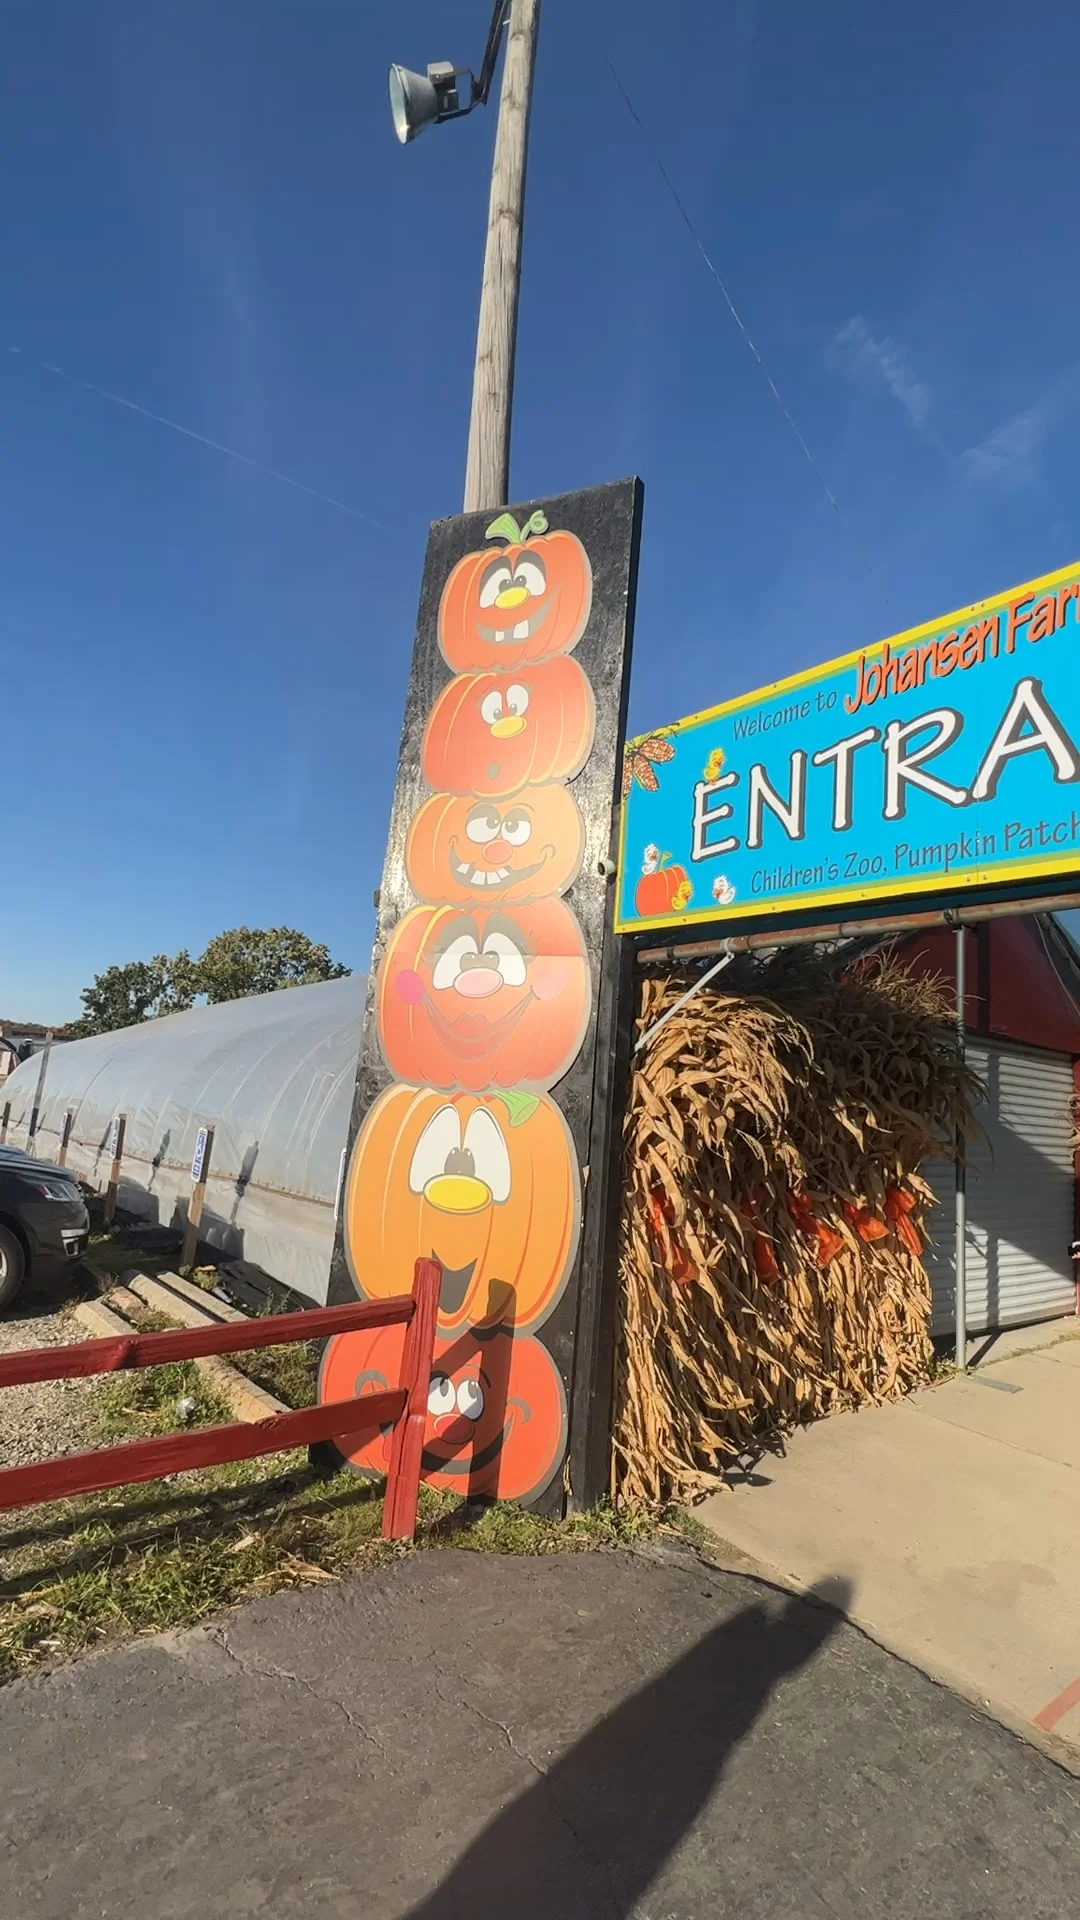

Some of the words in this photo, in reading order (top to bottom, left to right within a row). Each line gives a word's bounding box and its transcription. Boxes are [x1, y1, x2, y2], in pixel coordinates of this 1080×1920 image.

[733, 700, 811, 741] Welcome
[815, 691, 838, 713] to
[845, 614, 1000, 714] Johansen
[1007, 584, 1080, 654] Far
[690, 675, 1080, 862] ENTRA
[751, 856, 839, 894] Children's
[843, 852, 888, 878] Zoo,
[894, 830, 996, 873] Pumpkin
